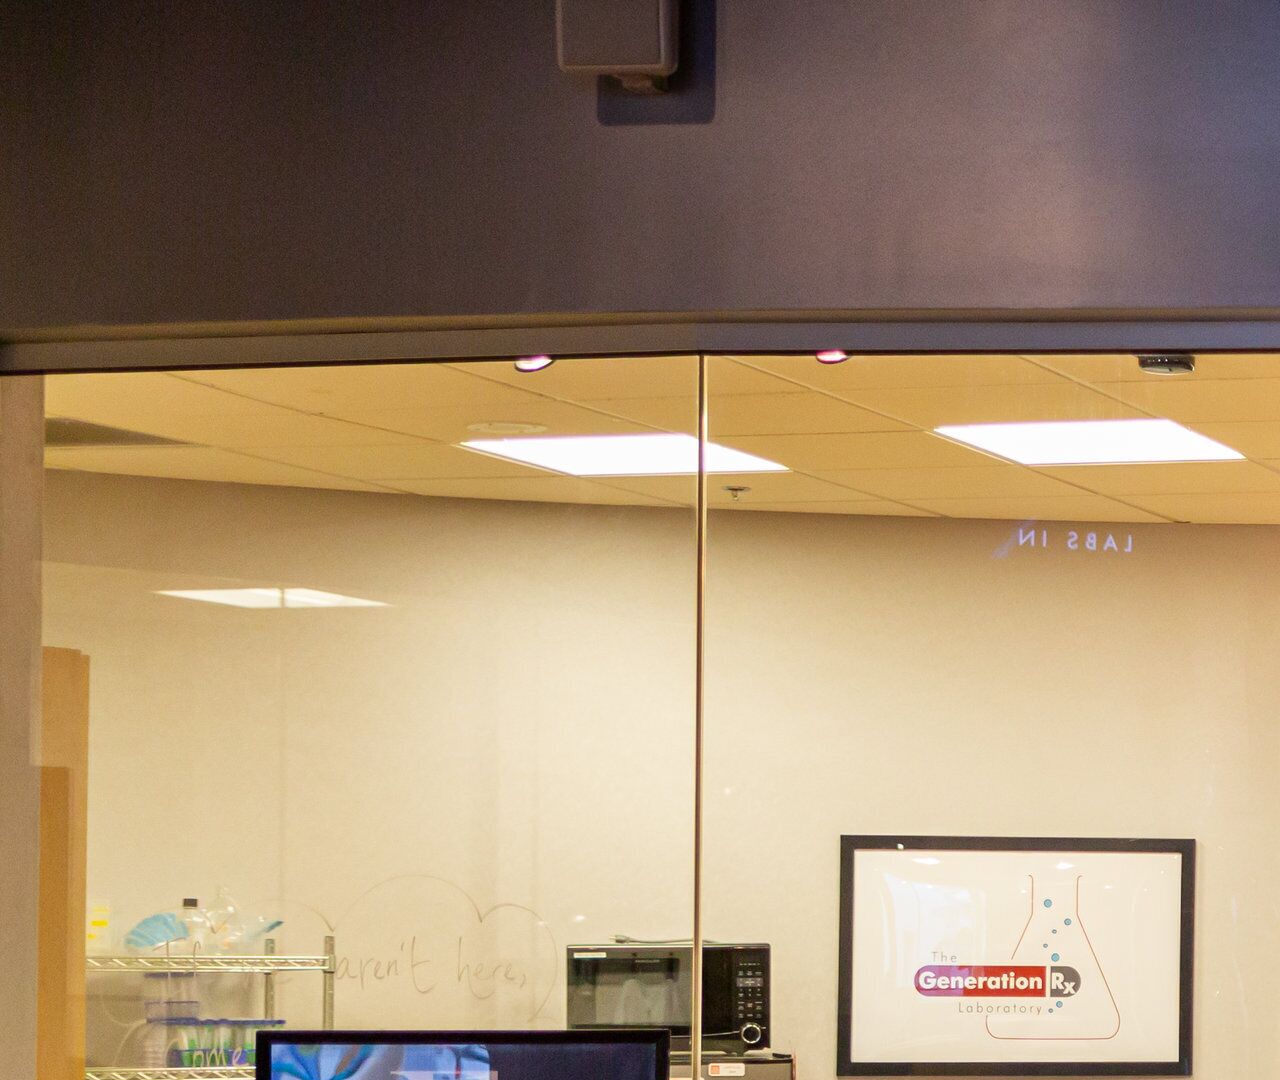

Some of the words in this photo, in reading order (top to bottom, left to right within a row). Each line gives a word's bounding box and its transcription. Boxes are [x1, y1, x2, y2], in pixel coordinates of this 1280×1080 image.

[931, 951, 958, 964] The
[917, 969, 1043, 991] Generation
[1050, 970, 1077, 996] Rx
[957, 1001, 1043, 1016] Laboratory
